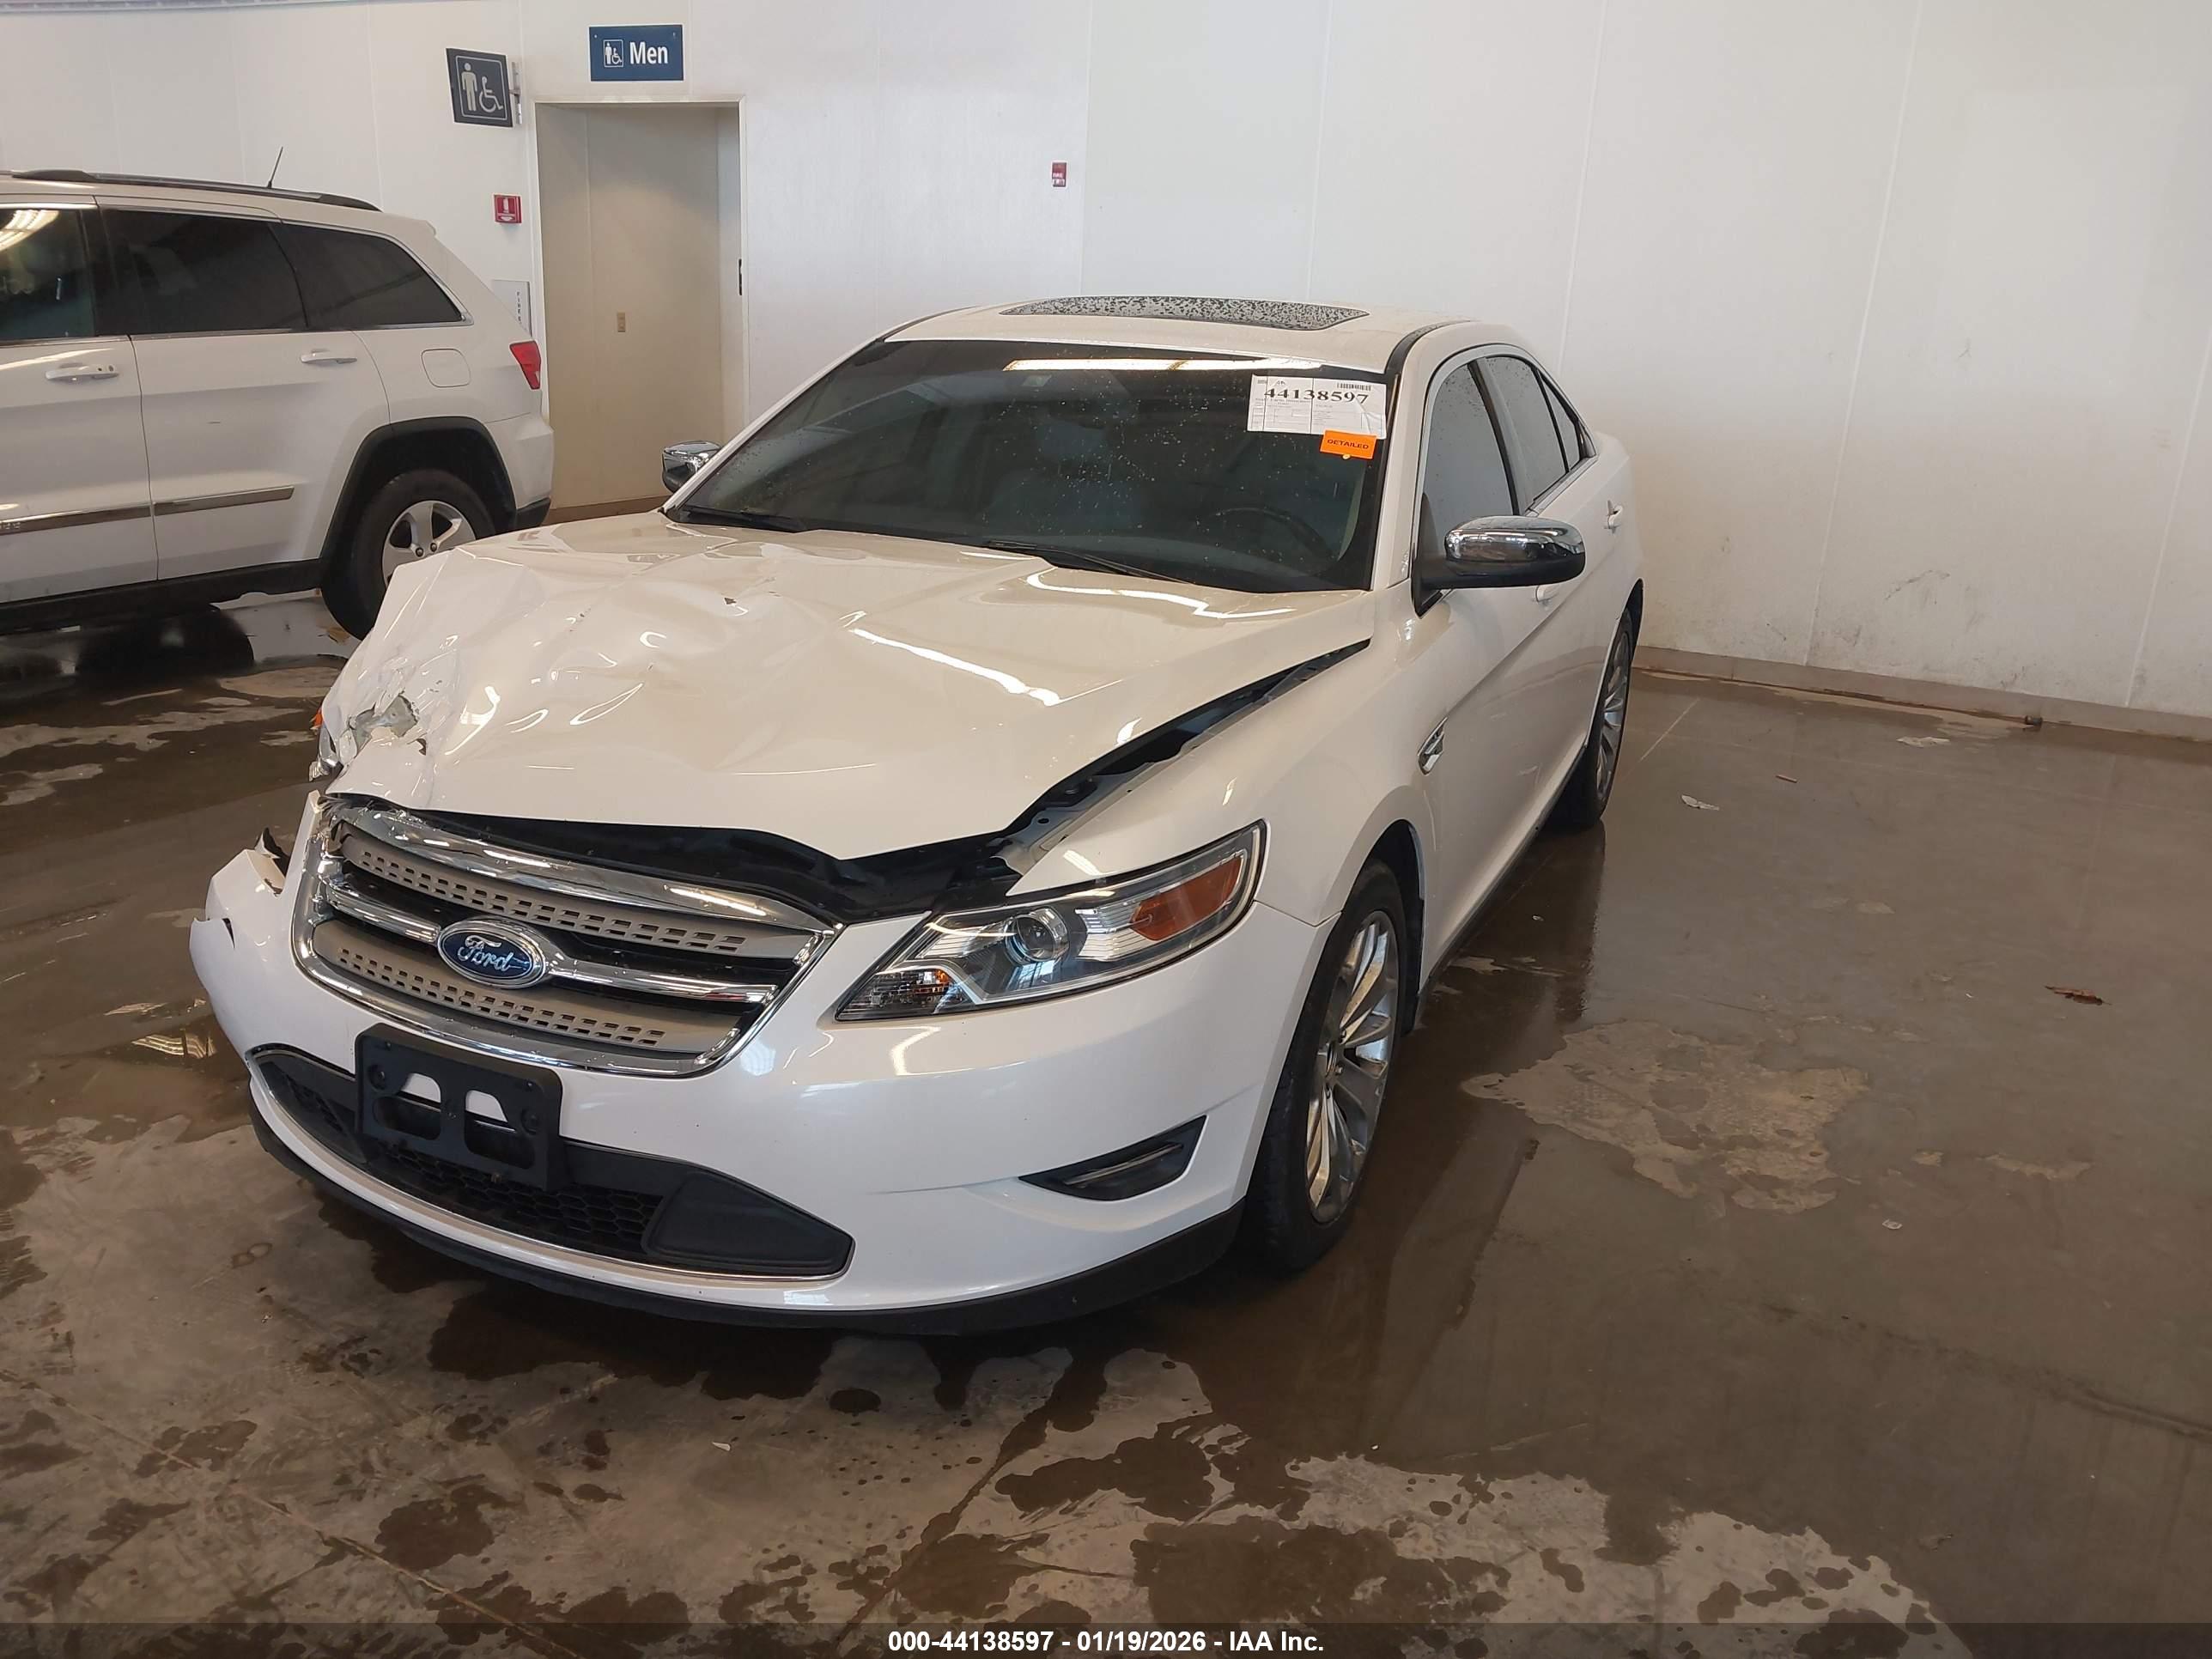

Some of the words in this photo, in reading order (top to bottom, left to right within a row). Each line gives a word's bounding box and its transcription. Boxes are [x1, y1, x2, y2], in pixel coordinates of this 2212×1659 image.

[629, 41, 668, 64] Men
[1264, 388, 1369, 404] 44138597
[1327, 439, 1370, 450] DETAILED
[457, 934, 526, 972] Ford
